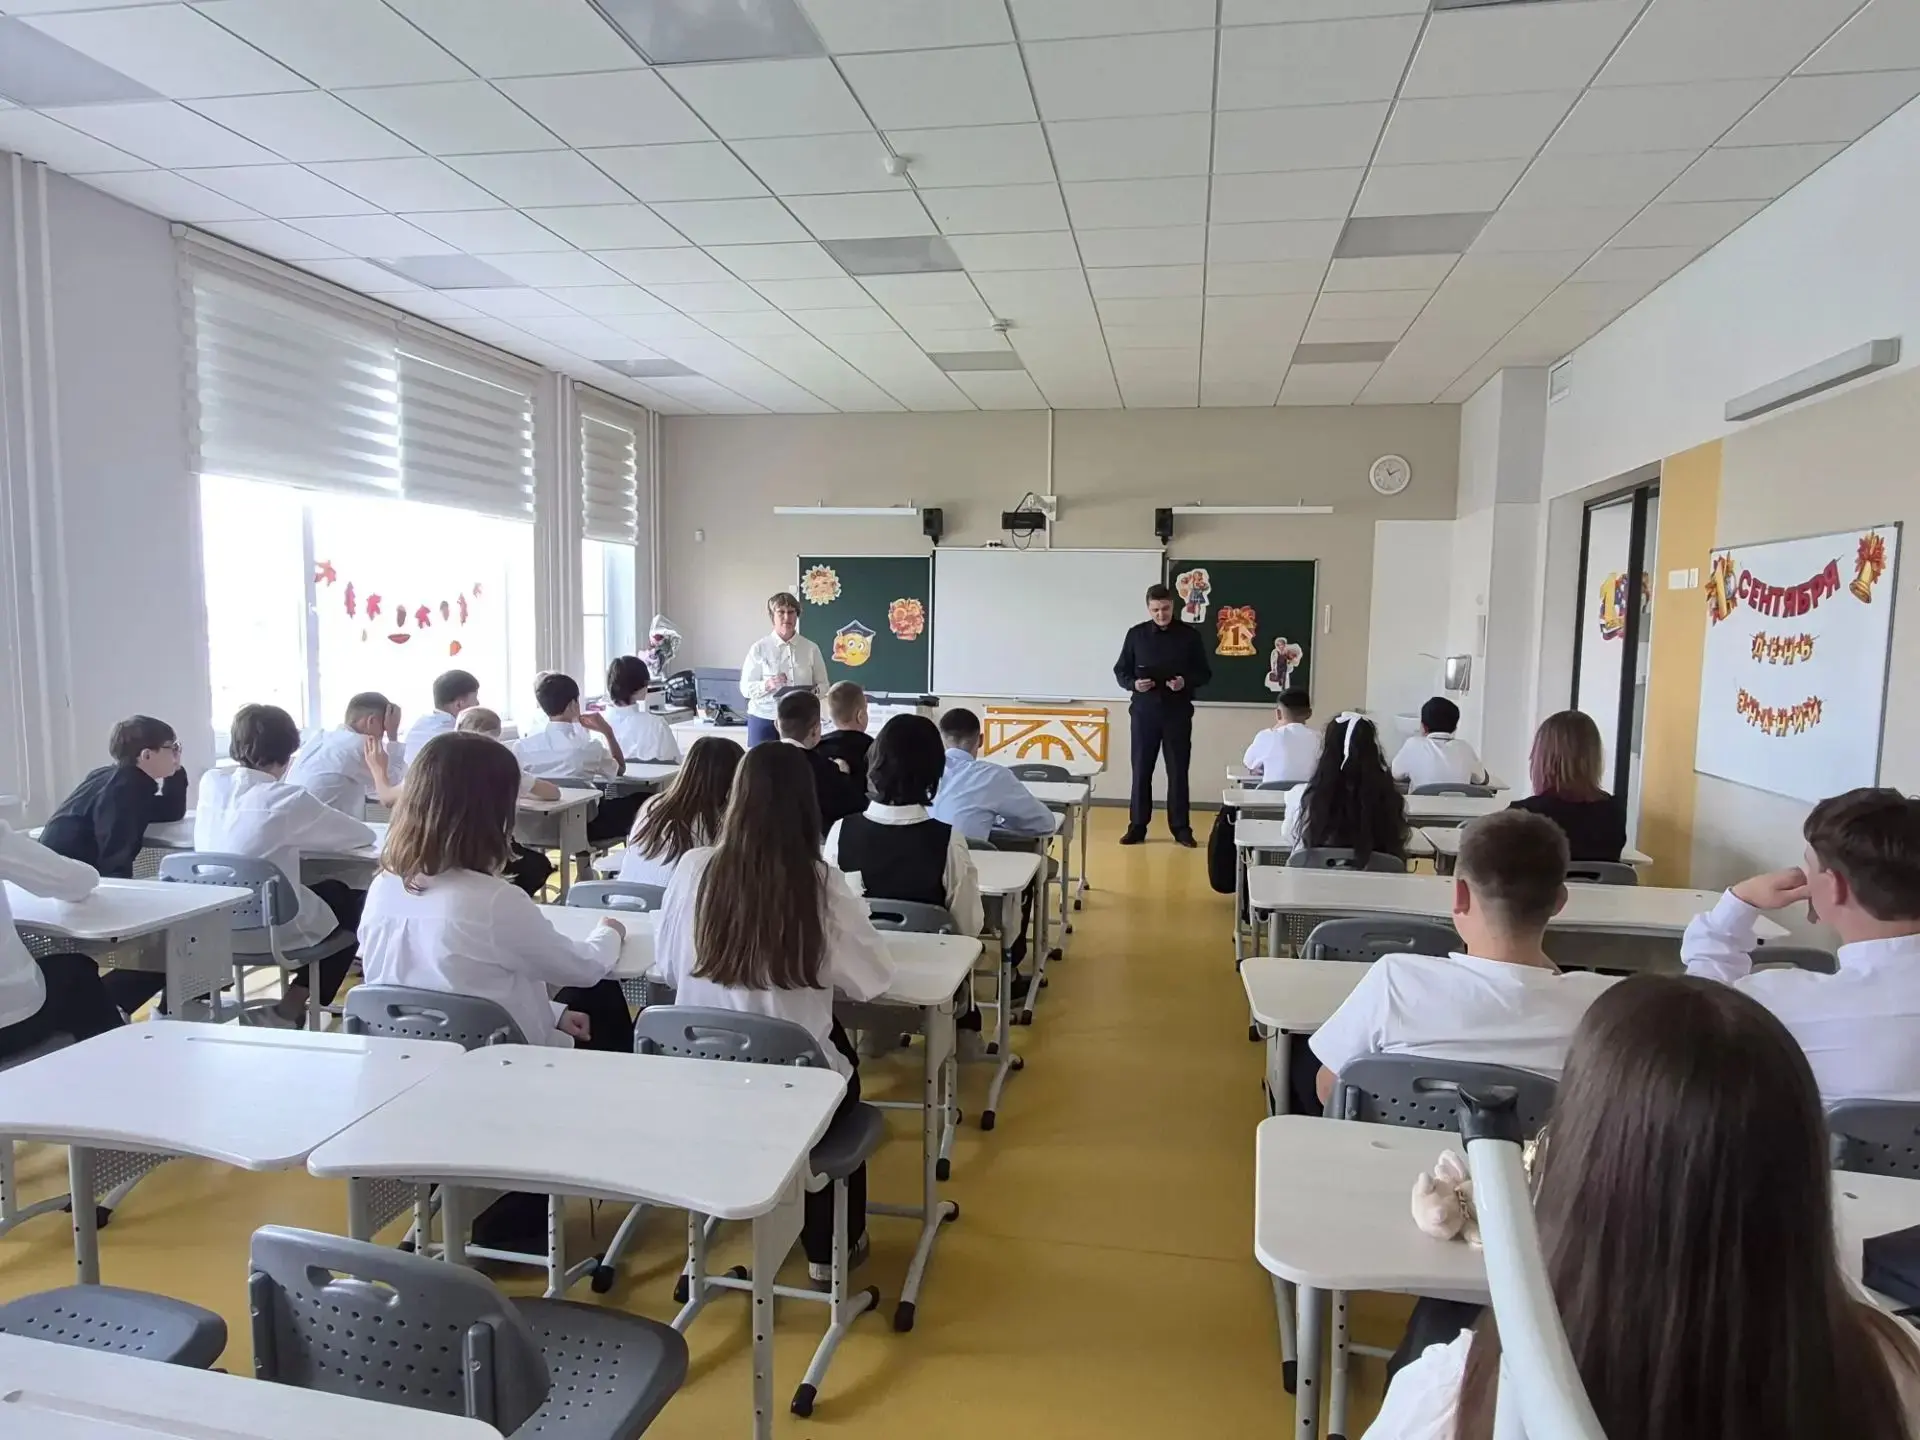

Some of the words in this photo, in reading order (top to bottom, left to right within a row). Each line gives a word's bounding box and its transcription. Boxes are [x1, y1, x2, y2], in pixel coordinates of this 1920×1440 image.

[1739, 559, 1840, 618] СЕНТЯБРЯ
[1231, 626, 1239, 645] 1
[1752, 633, 1812, 665] ДЕНЬ
[1737, 689, 1822, 737] ЗНАНИЙ
